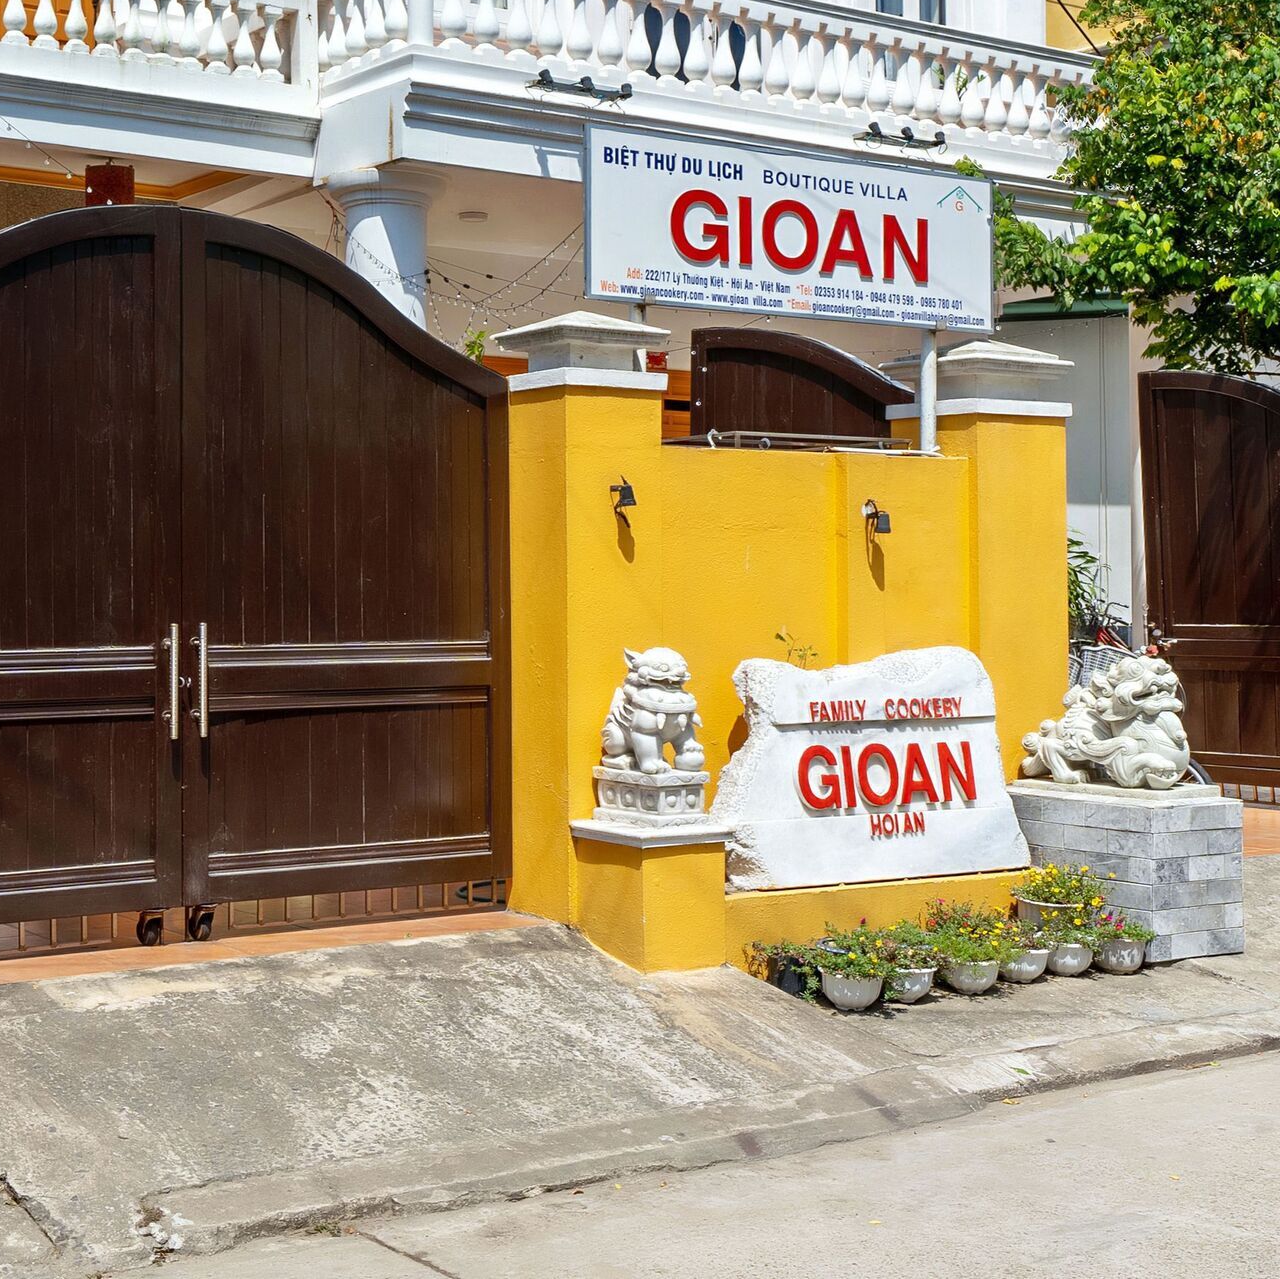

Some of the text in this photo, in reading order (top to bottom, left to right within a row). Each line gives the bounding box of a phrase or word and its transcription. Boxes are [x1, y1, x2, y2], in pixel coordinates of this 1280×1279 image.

[603, 145, 743, 181] BIỆT THỰ DU LỊCH
[763, 170, 908, 201] BOUTIQUE VILLA
[670, 189, 928, 284] GIOAN
[645, 269, 670, 282] 222/17
[744, 279, 753, 290] An
[775, 282, 790, 294] Nam
[837, 288, 849, 299] 914
[809, 697, 962, 722] FAMILY COOKERY
[797, 741, 977, 810] GIOAN
[870, 812, 925, 836] HOI AN
